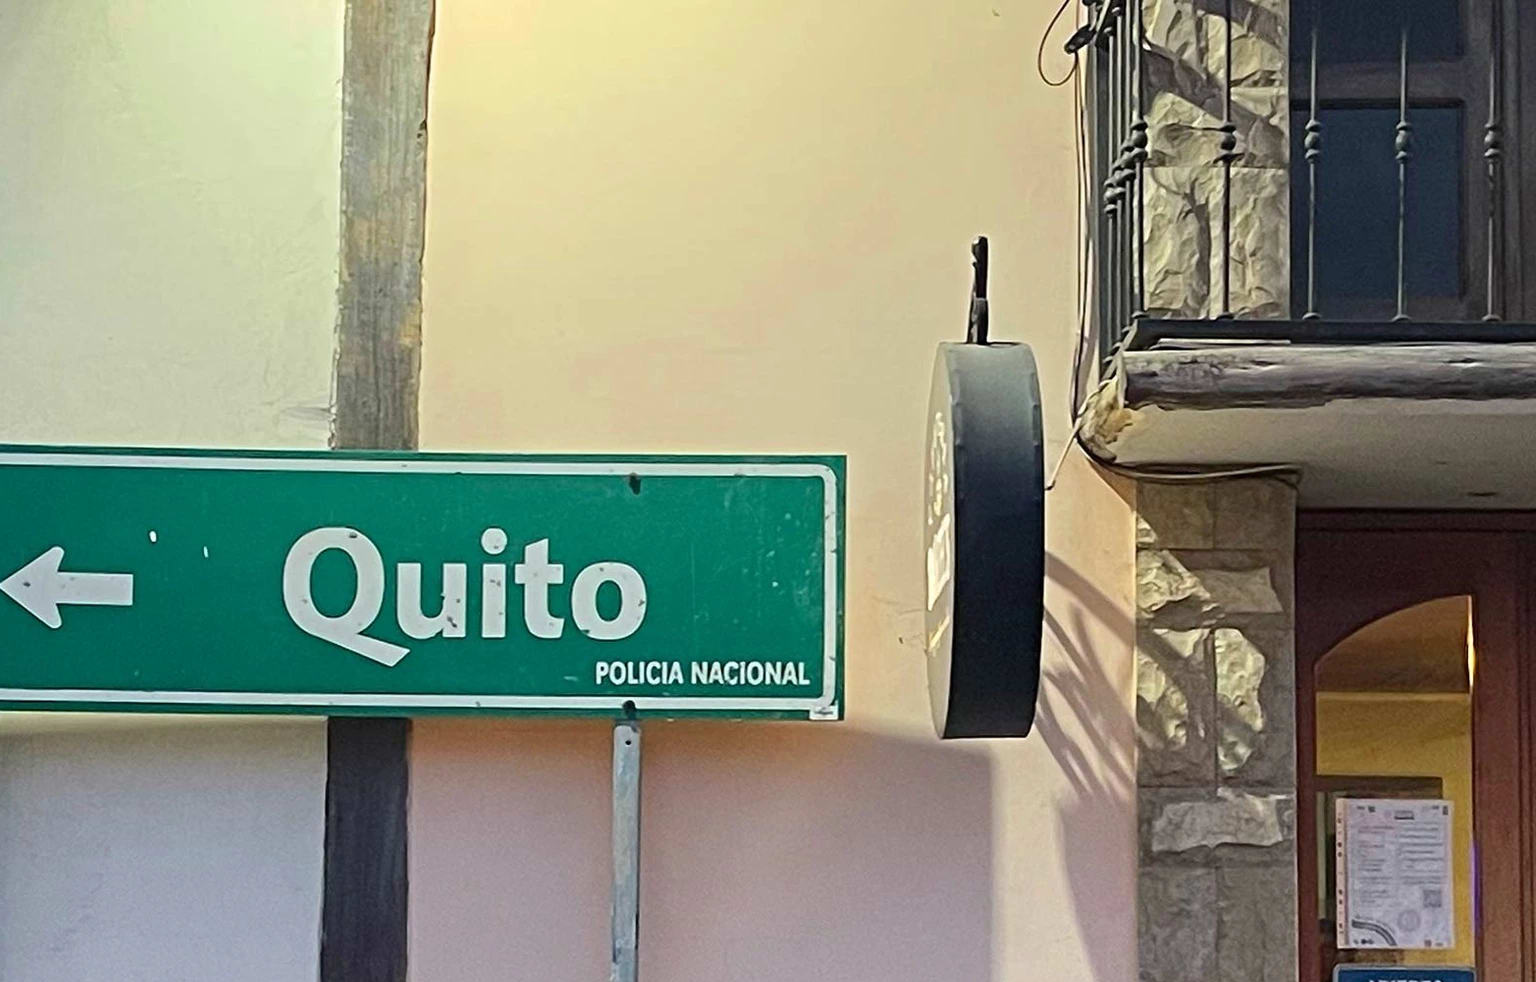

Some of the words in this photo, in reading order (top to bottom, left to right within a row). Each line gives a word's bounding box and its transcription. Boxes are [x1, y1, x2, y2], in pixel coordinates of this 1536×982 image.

[282, 526, 647, 668] Quito
[596, 661, 684, 686] POLICIA
[691, 660, 810, 686] NACIONAL
